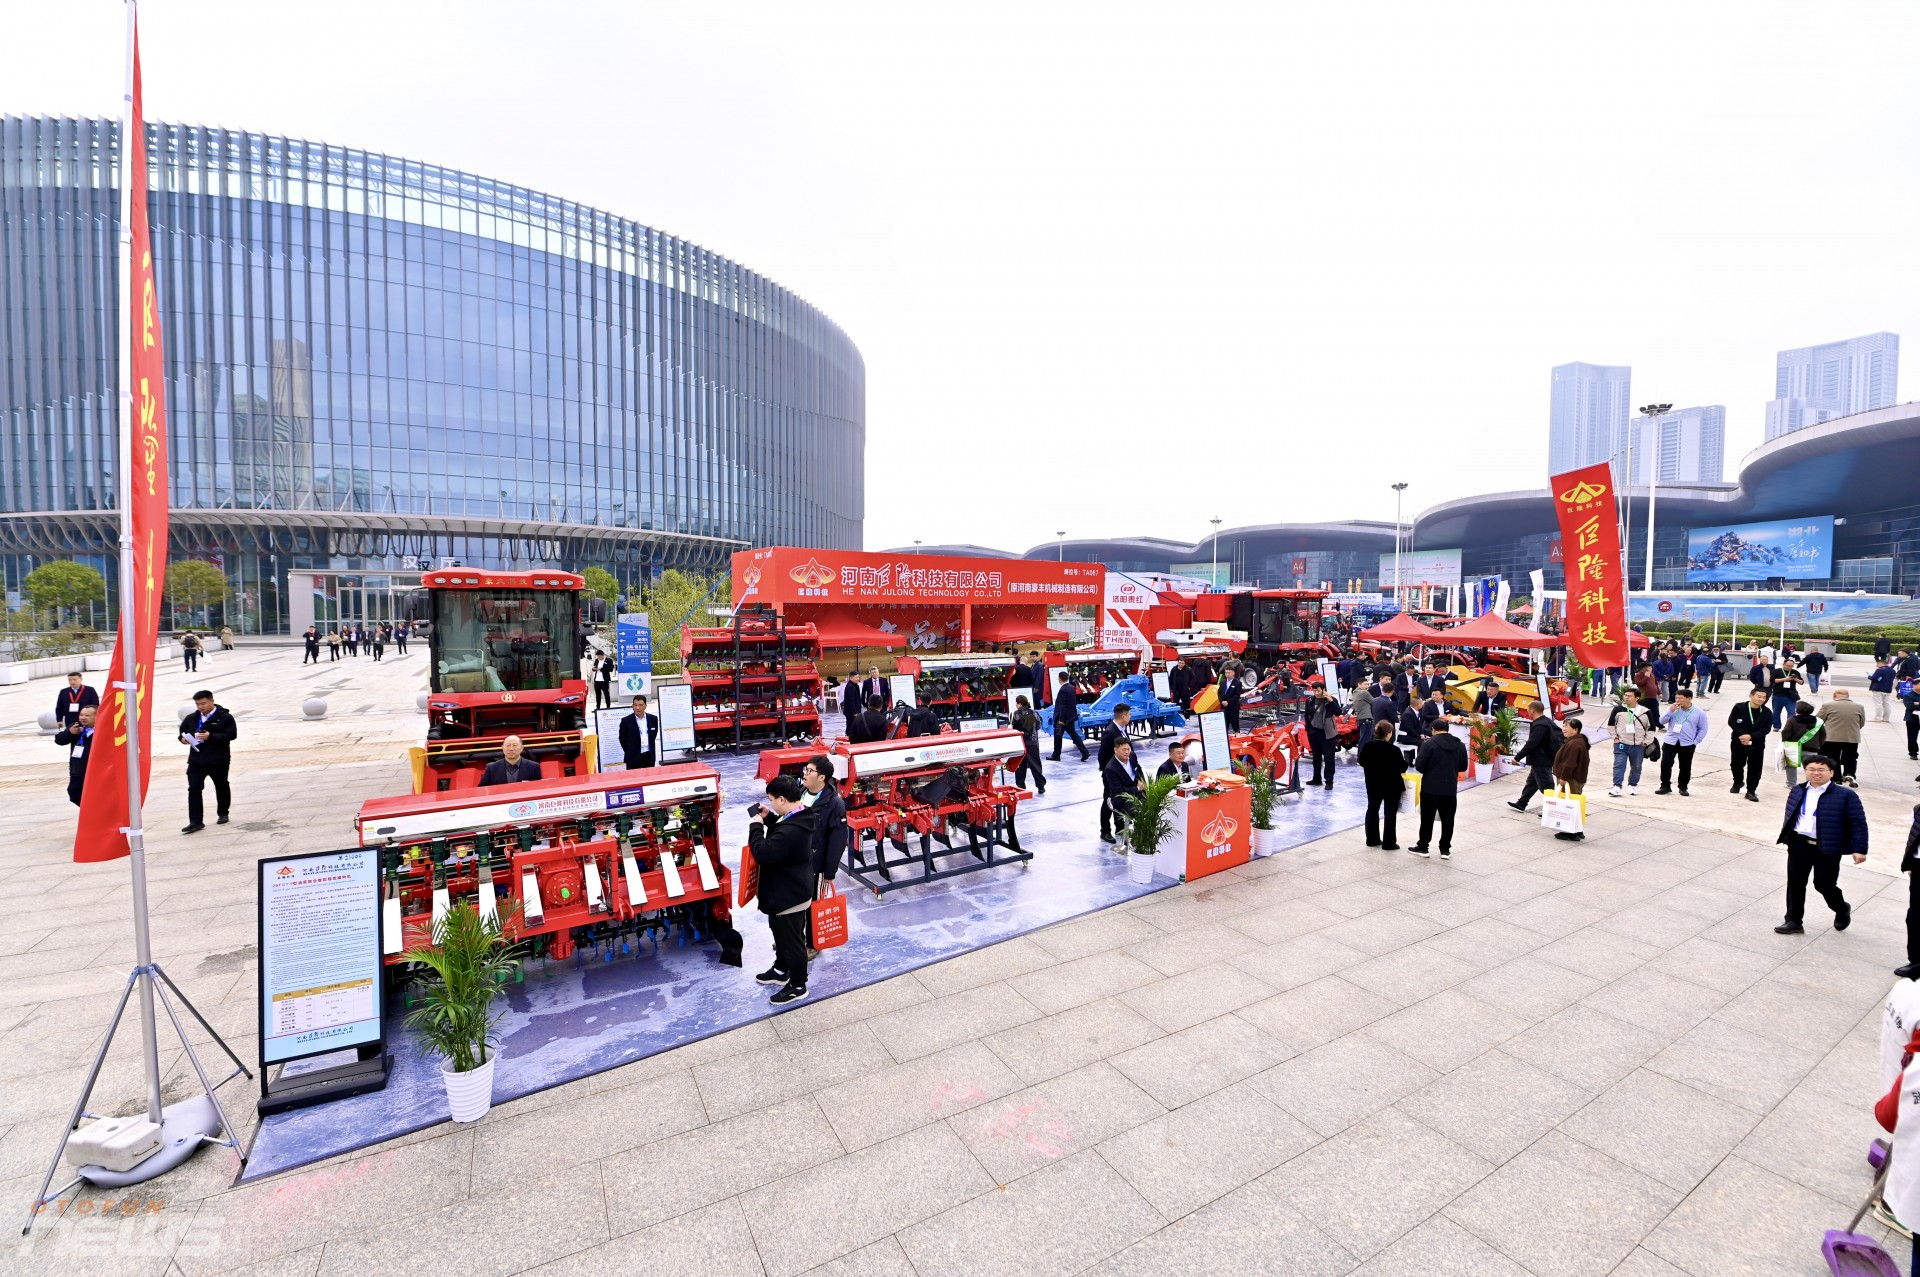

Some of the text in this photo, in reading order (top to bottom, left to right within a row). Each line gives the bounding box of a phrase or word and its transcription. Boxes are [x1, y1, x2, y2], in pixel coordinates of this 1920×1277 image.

[841, 562, 1002, 588] 河南巨隆科技有限公司
[1293, 562, 1304, 571] A4
[1574, 515, 1616, 645] 巨隆科技
[842, 588, 1002, 598] HE NAN JULONG TECHNOLOGY CO.,LTD
